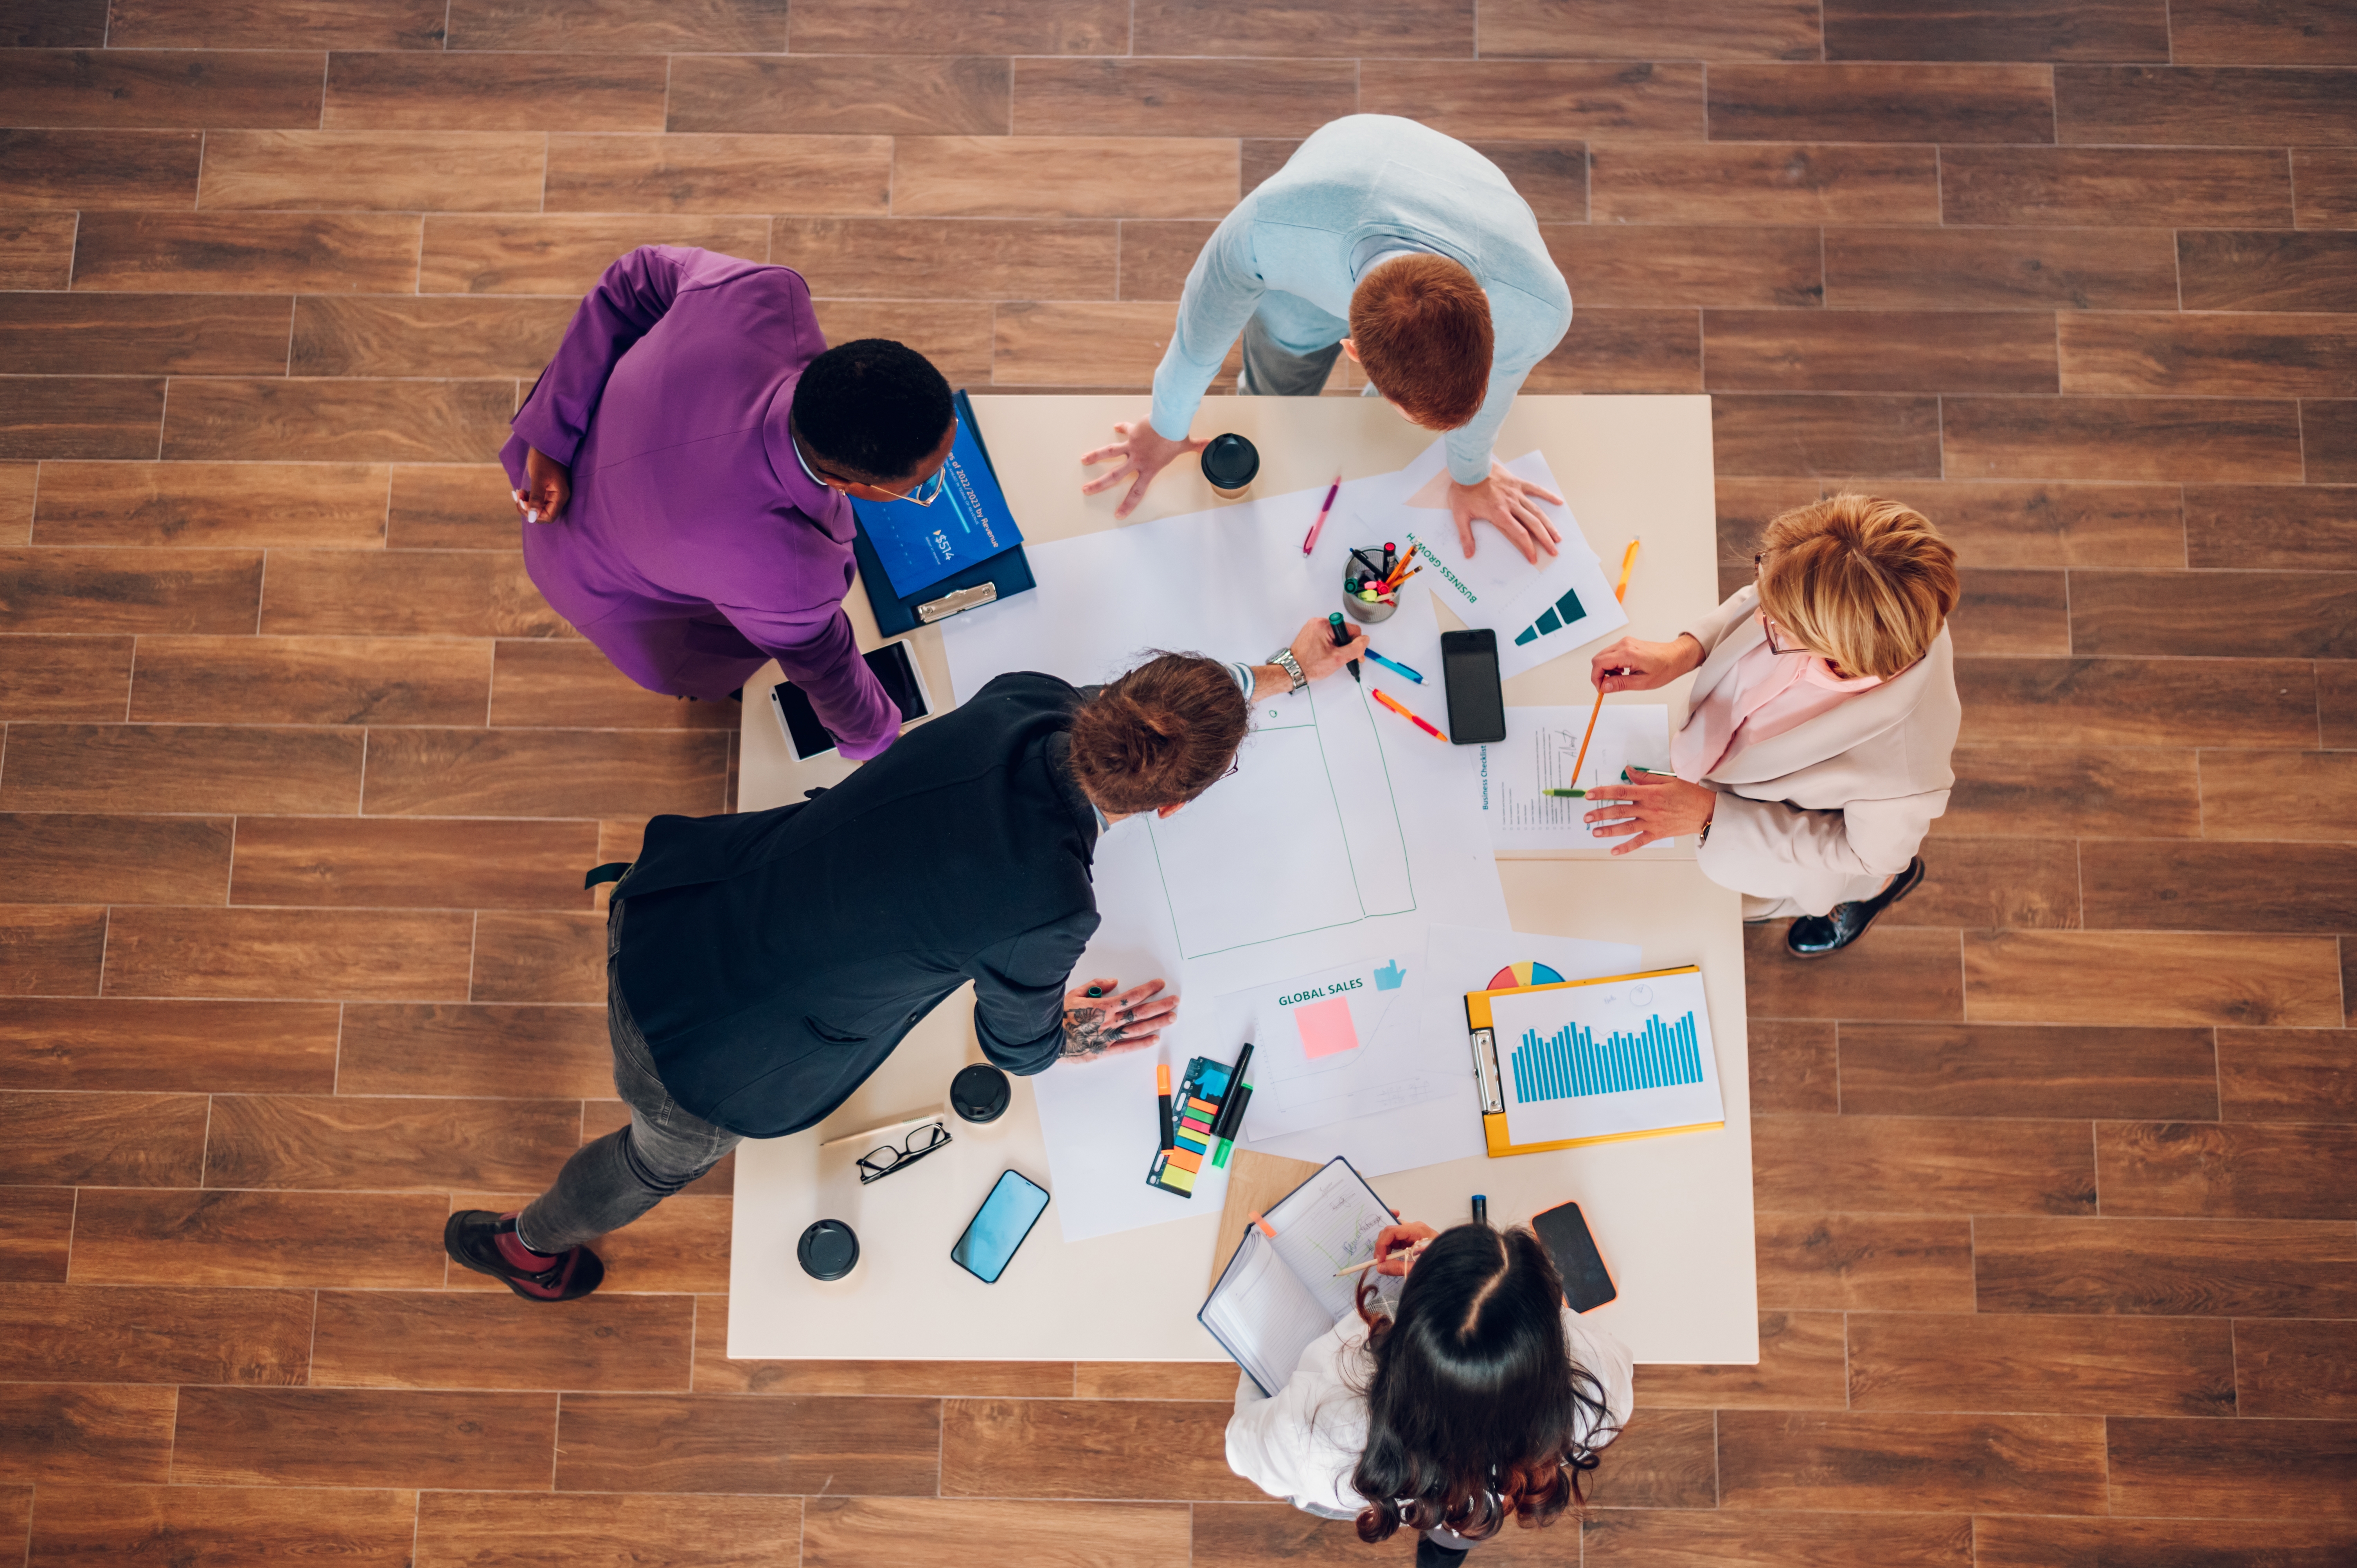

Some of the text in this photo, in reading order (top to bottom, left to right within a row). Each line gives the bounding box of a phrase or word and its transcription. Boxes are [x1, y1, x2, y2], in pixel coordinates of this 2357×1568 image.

[956, 469, 980, 508] 2022/2023
[976, 508, 983, 517] by
[981, 518, 998, 548] Revenue
[935, 535, 954, 560] $514
[1406, 532, 1477, 603] BUSINESS GROWH
[1279, 978, 1363, 1005] GLOBAL SALES
